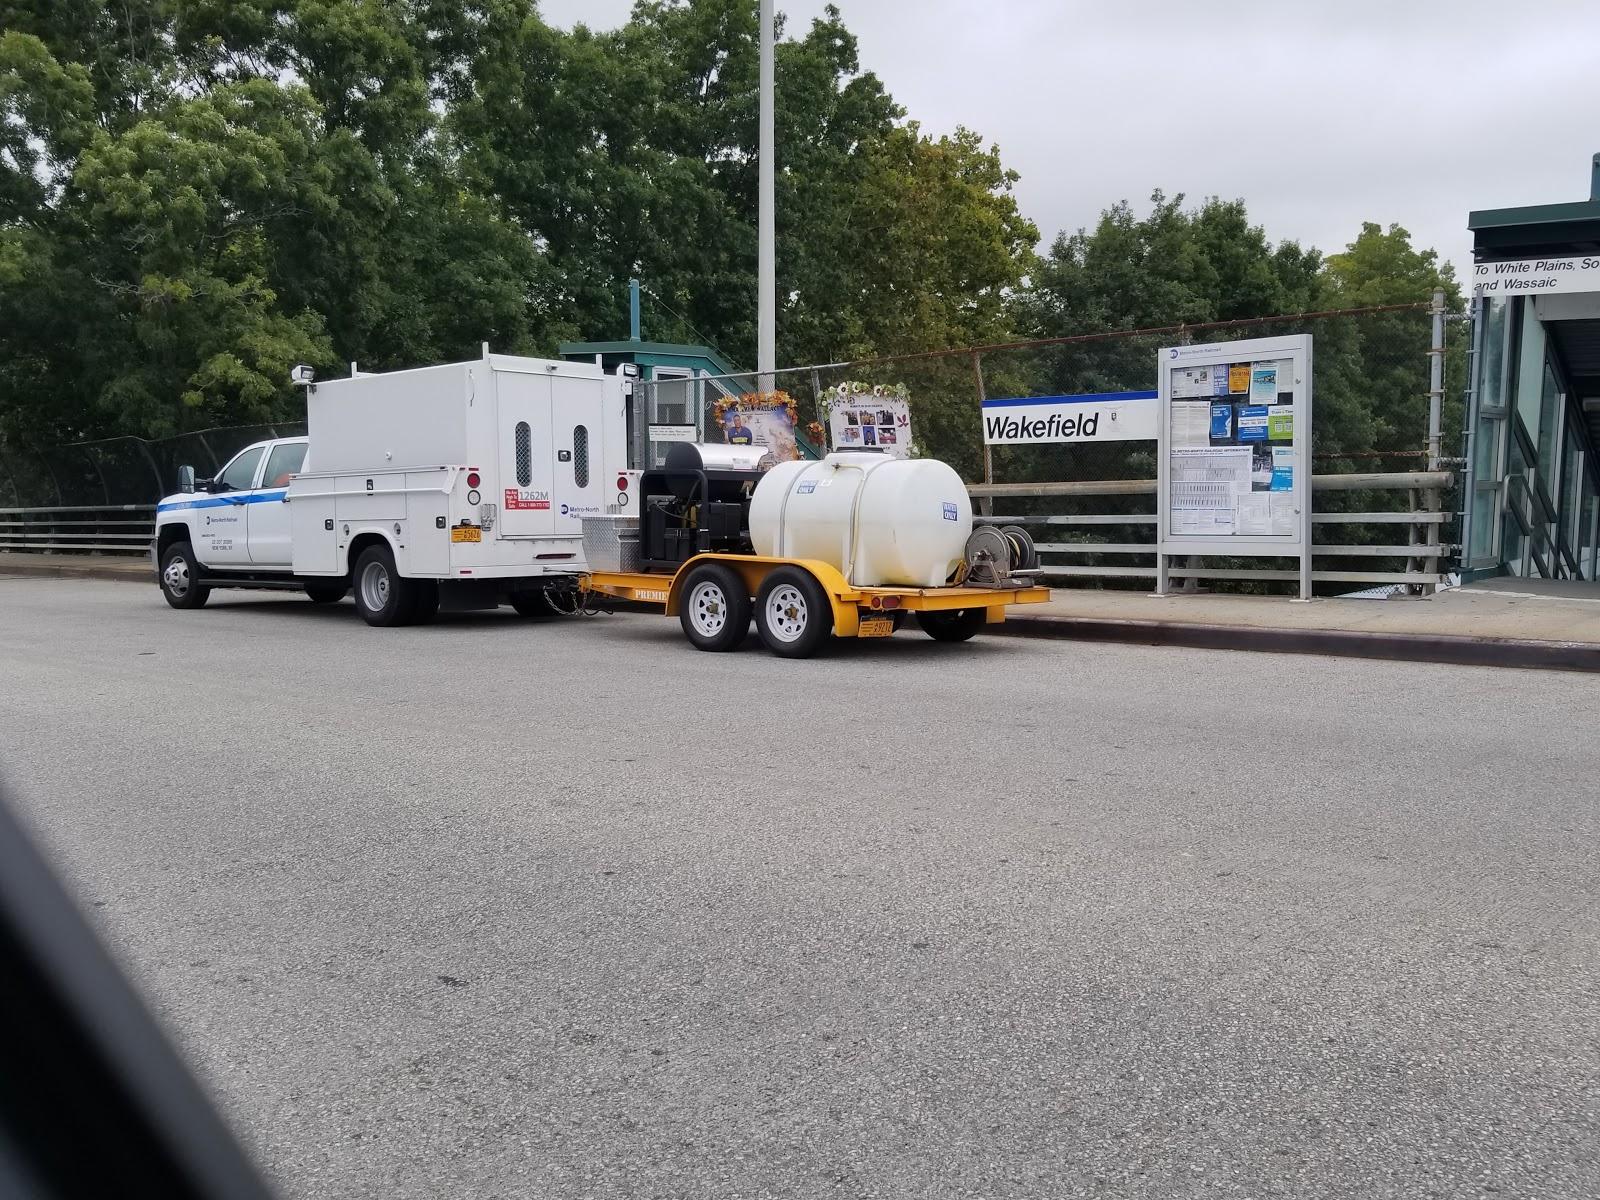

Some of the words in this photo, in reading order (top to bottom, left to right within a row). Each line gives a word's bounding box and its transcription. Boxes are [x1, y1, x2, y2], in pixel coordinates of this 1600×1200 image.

[1475, 265, 1489, 275] To
[1495, 263, 1531, 274] White
[1534, 260, 1576, 272] Plains,
[1581, 257, 1600, 270] So
[1504, 276, 1558, 290] Wassaic
[986, 412, 1100, 440] Wakefield
[520, 491, 549, 501] 1262M
[944, 511, 957, 520] ONLY
[635, 589, 668, 600] PREMIE
